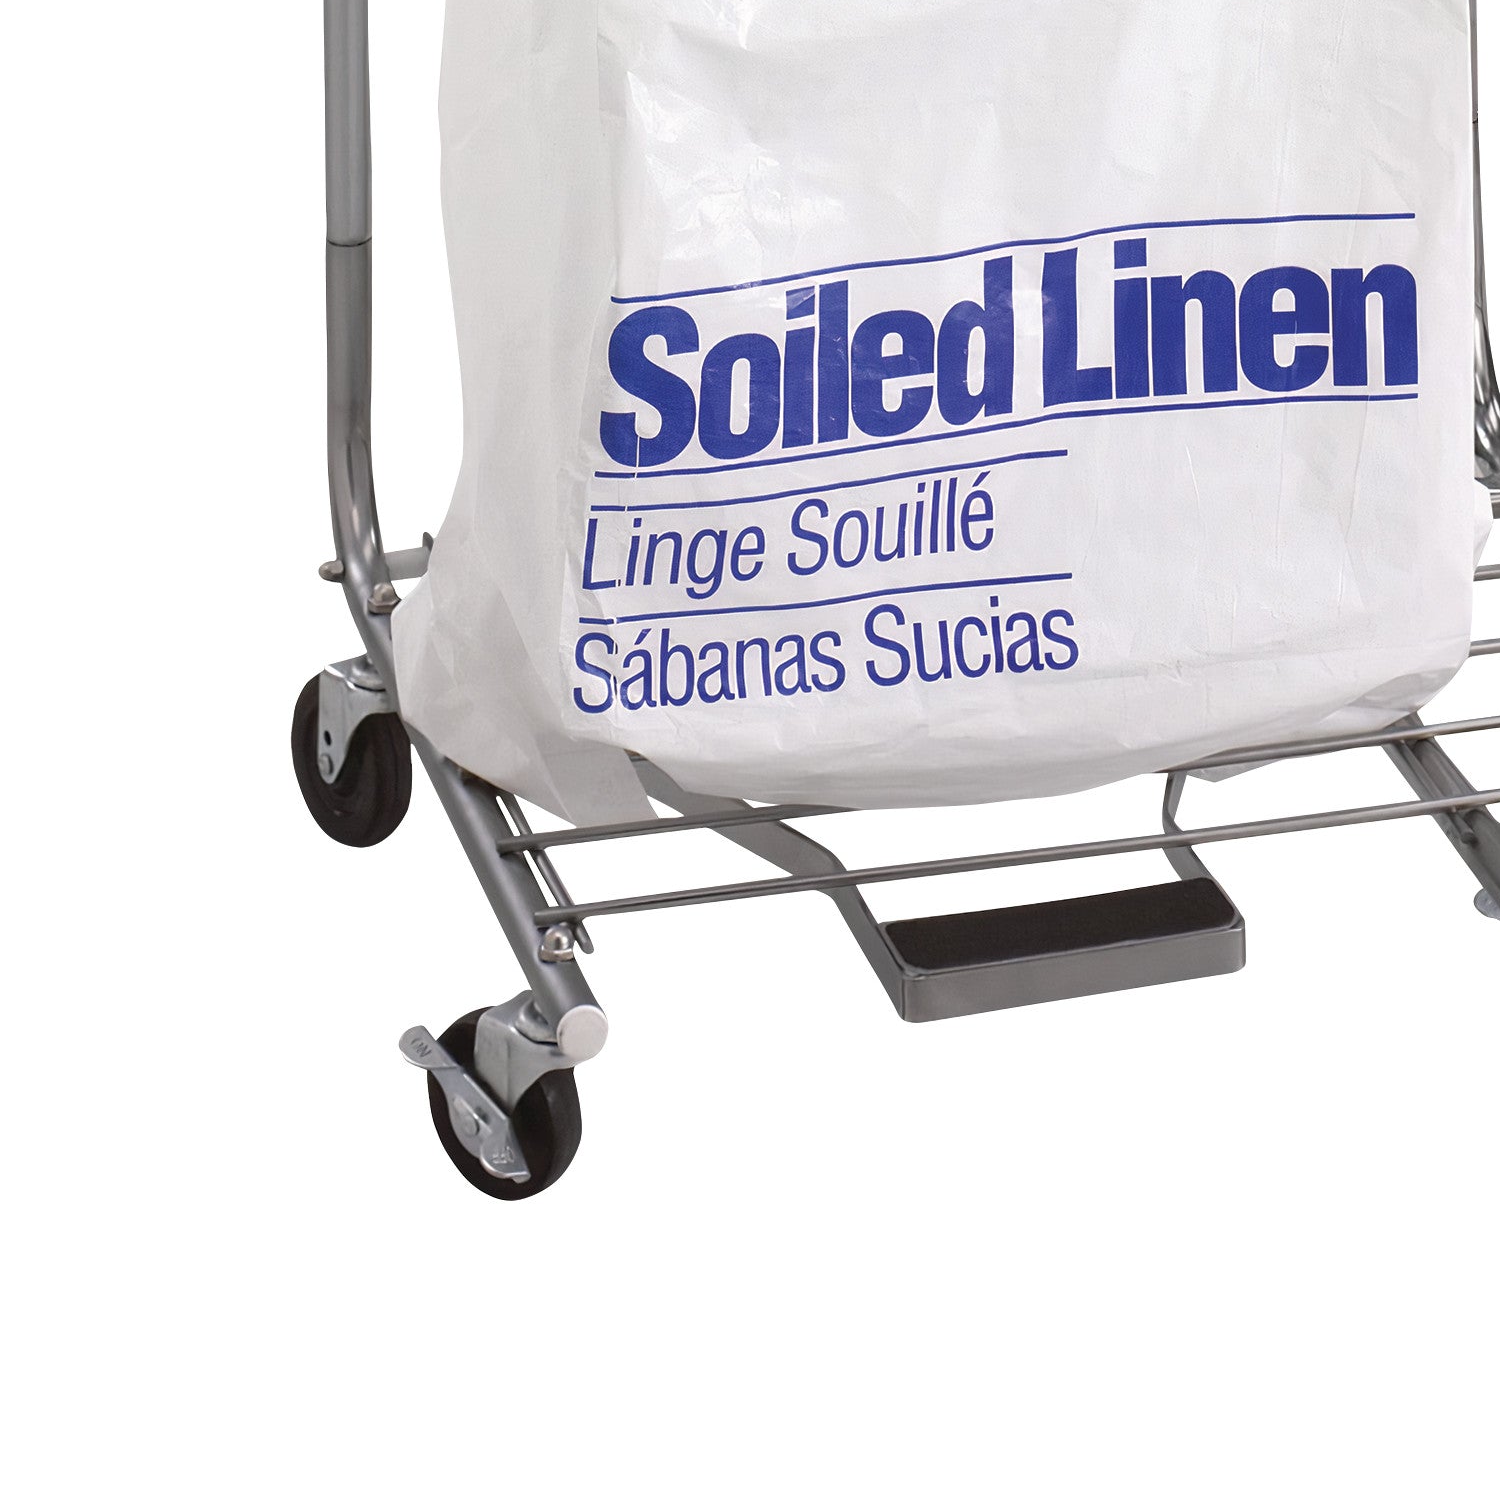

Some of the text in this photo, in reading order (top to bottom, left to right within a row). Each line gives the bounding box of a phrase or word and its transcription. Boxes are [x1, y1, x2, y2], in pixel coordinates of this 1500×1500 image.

[599, 237, 1419, 468] Soiled Linen
[582, 471, 994, 600] Linge Souillé
[573, 595, 1079, 714] Sábanas Sucias
